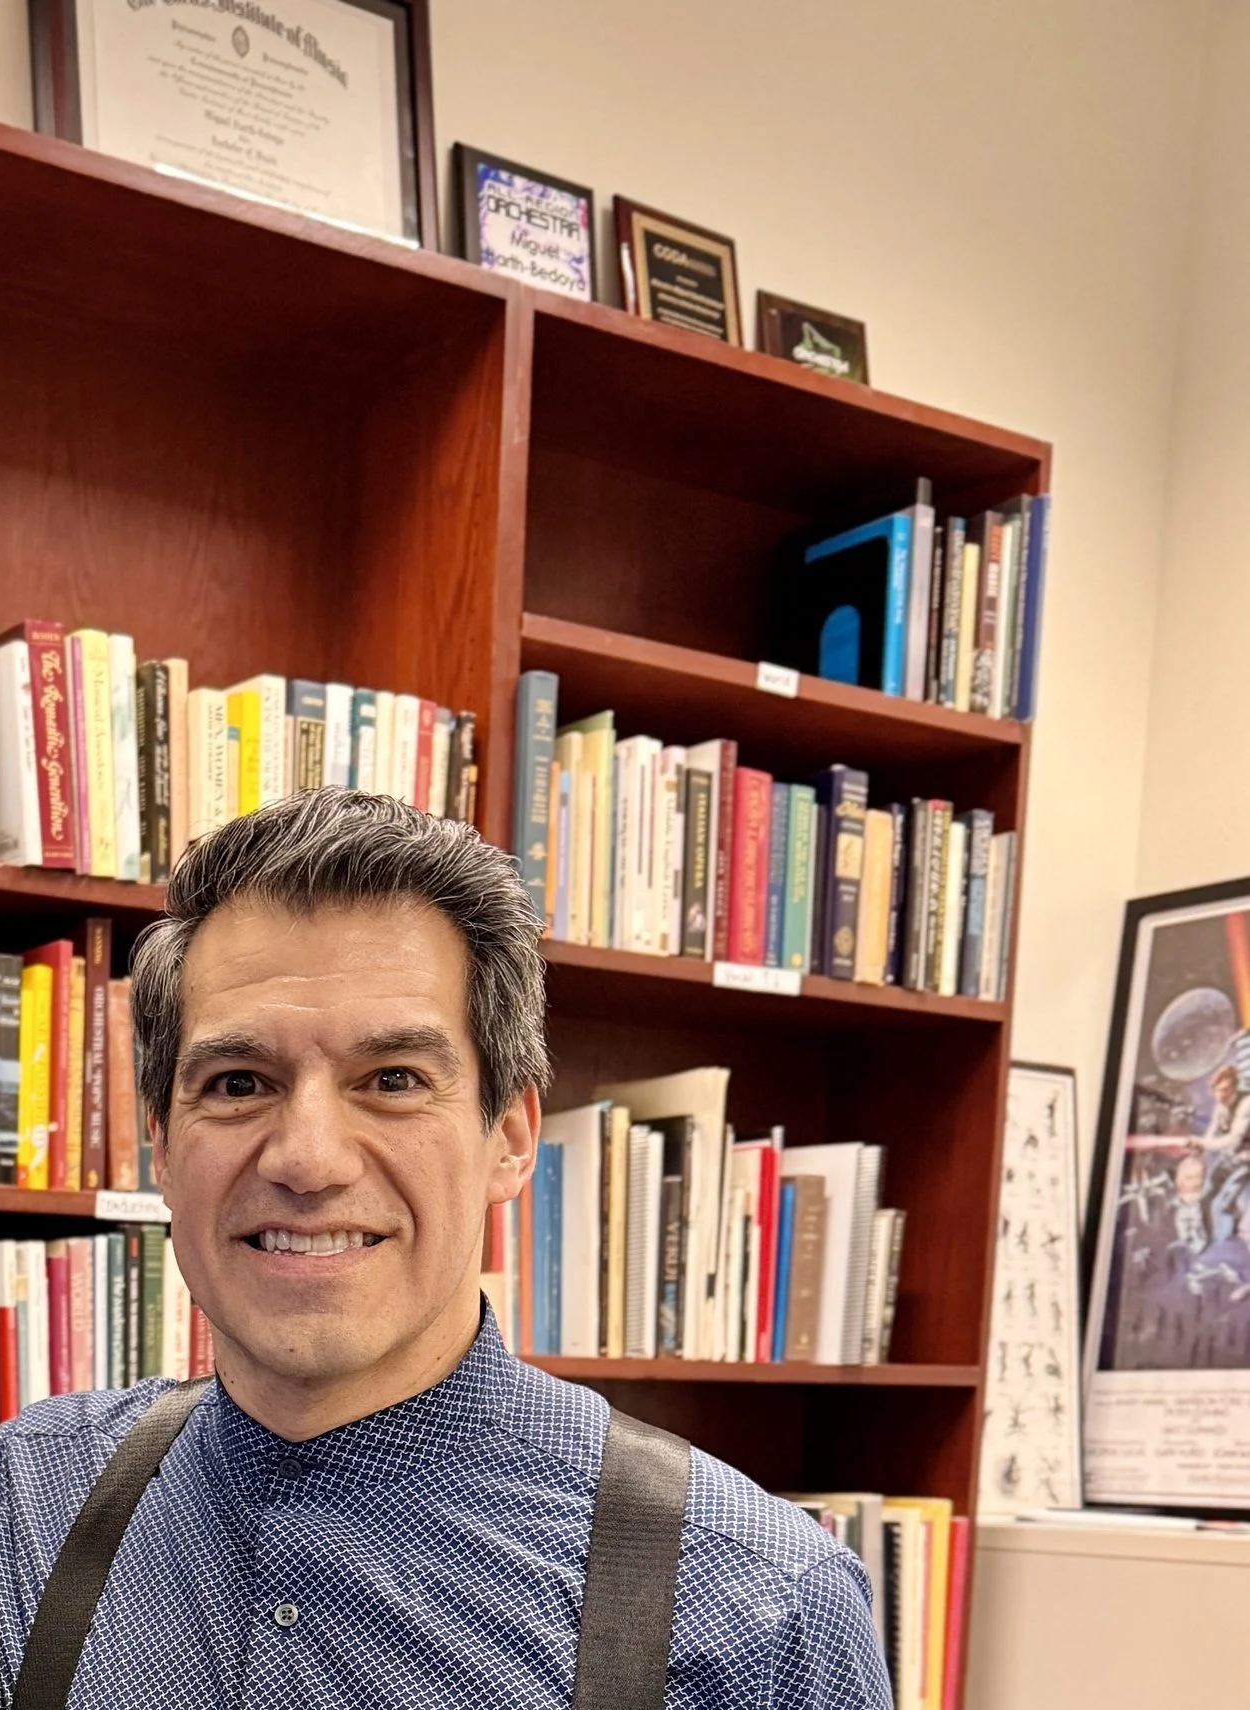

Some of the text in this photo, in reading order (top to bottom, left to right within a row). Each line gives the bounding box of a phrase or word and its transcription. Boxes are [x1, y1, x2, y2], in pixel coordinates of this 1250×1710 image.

[486, 194, 581, 241] ORCHESTRA
[40, 650, 69, 840] The Romantic Generation
[694, 793, 706, 888] ITALIAN OPERA
